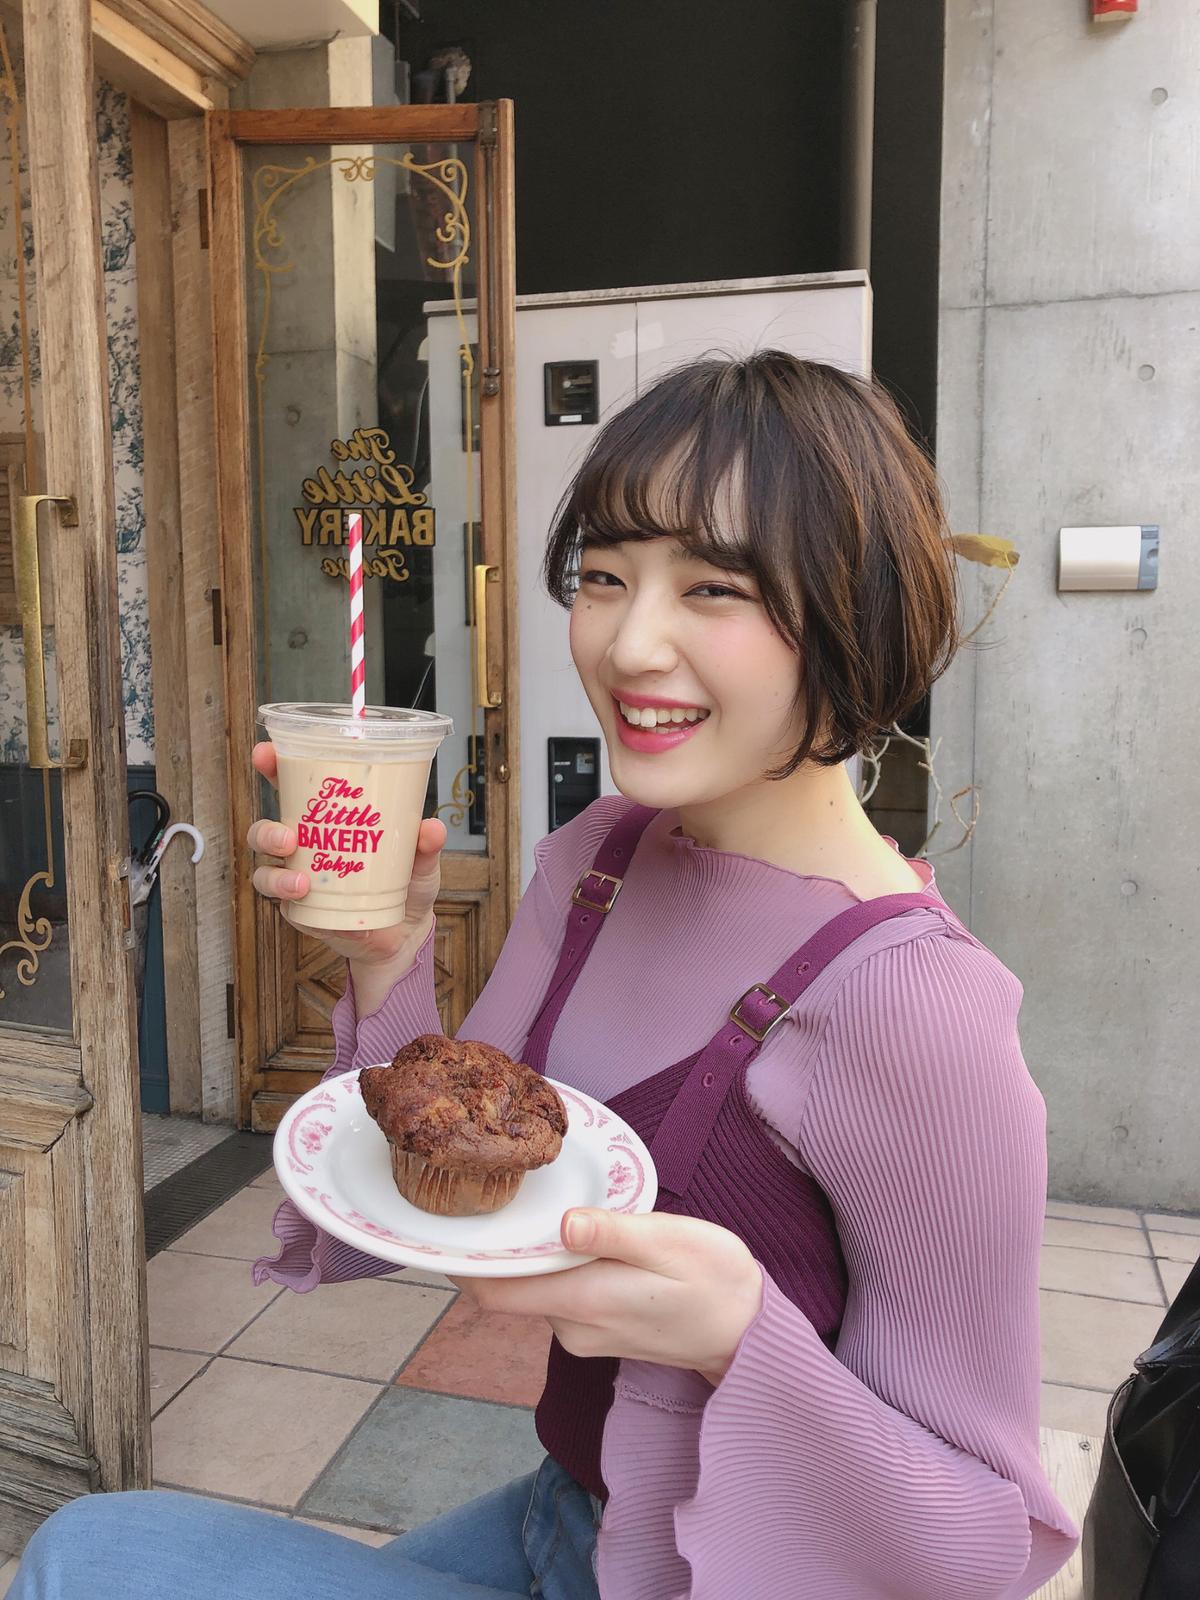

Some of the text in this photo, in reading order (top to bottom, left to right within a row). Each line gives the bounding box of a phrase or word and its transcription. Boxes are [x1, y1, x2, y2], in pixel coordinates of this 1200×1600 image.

[319, 777, 364, 799] The
[301, 799, 381, 827] Little
[297, 823, 384, 853] BAKERY
[311, 853, 364, 878] Tokyo
